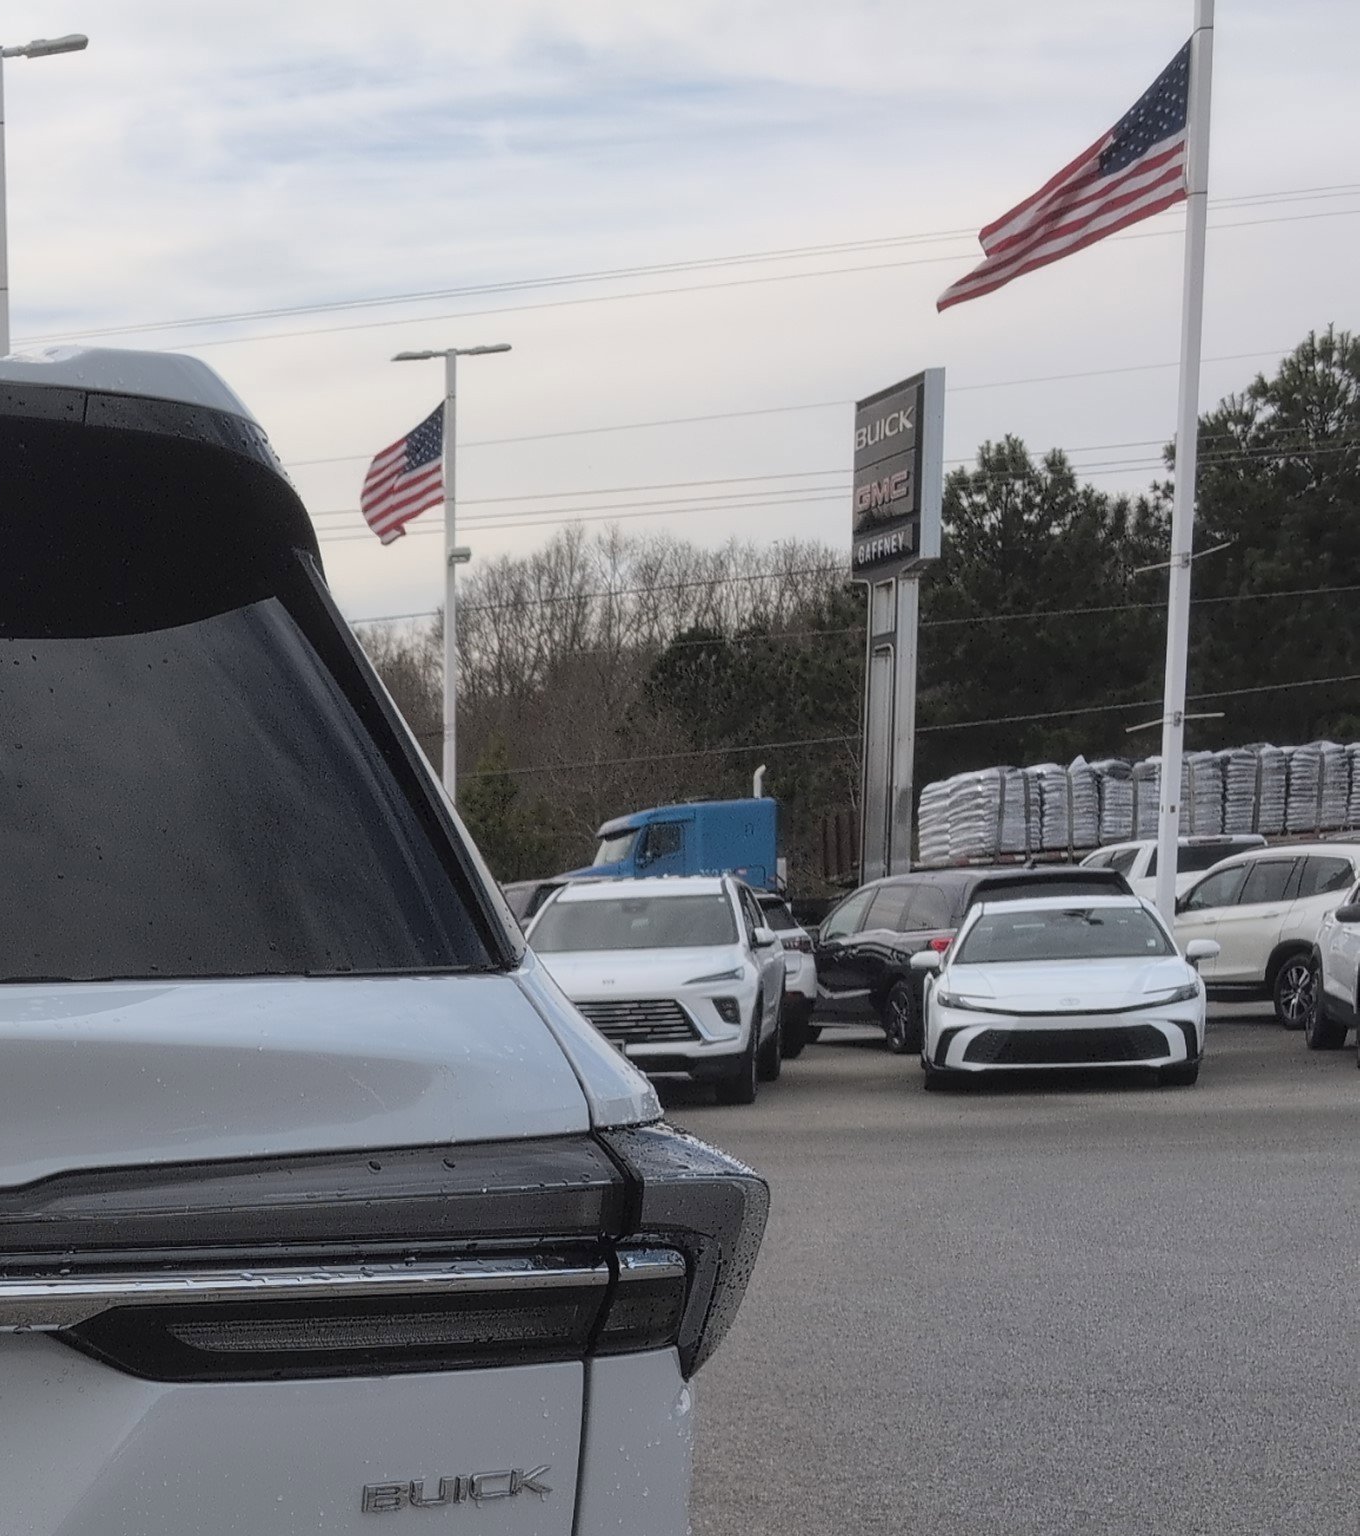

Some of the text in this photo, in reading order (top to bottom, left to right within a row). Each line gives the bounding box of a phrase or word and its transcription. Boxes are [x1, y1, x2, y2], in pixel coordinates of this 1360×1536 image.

[855, 406, 914, 450] BUICK
[855, 469, 910, 514] GMC
[857, 531, 905, 564] GAFFNEY
[361, 1464, 553, 1513] BUICK
